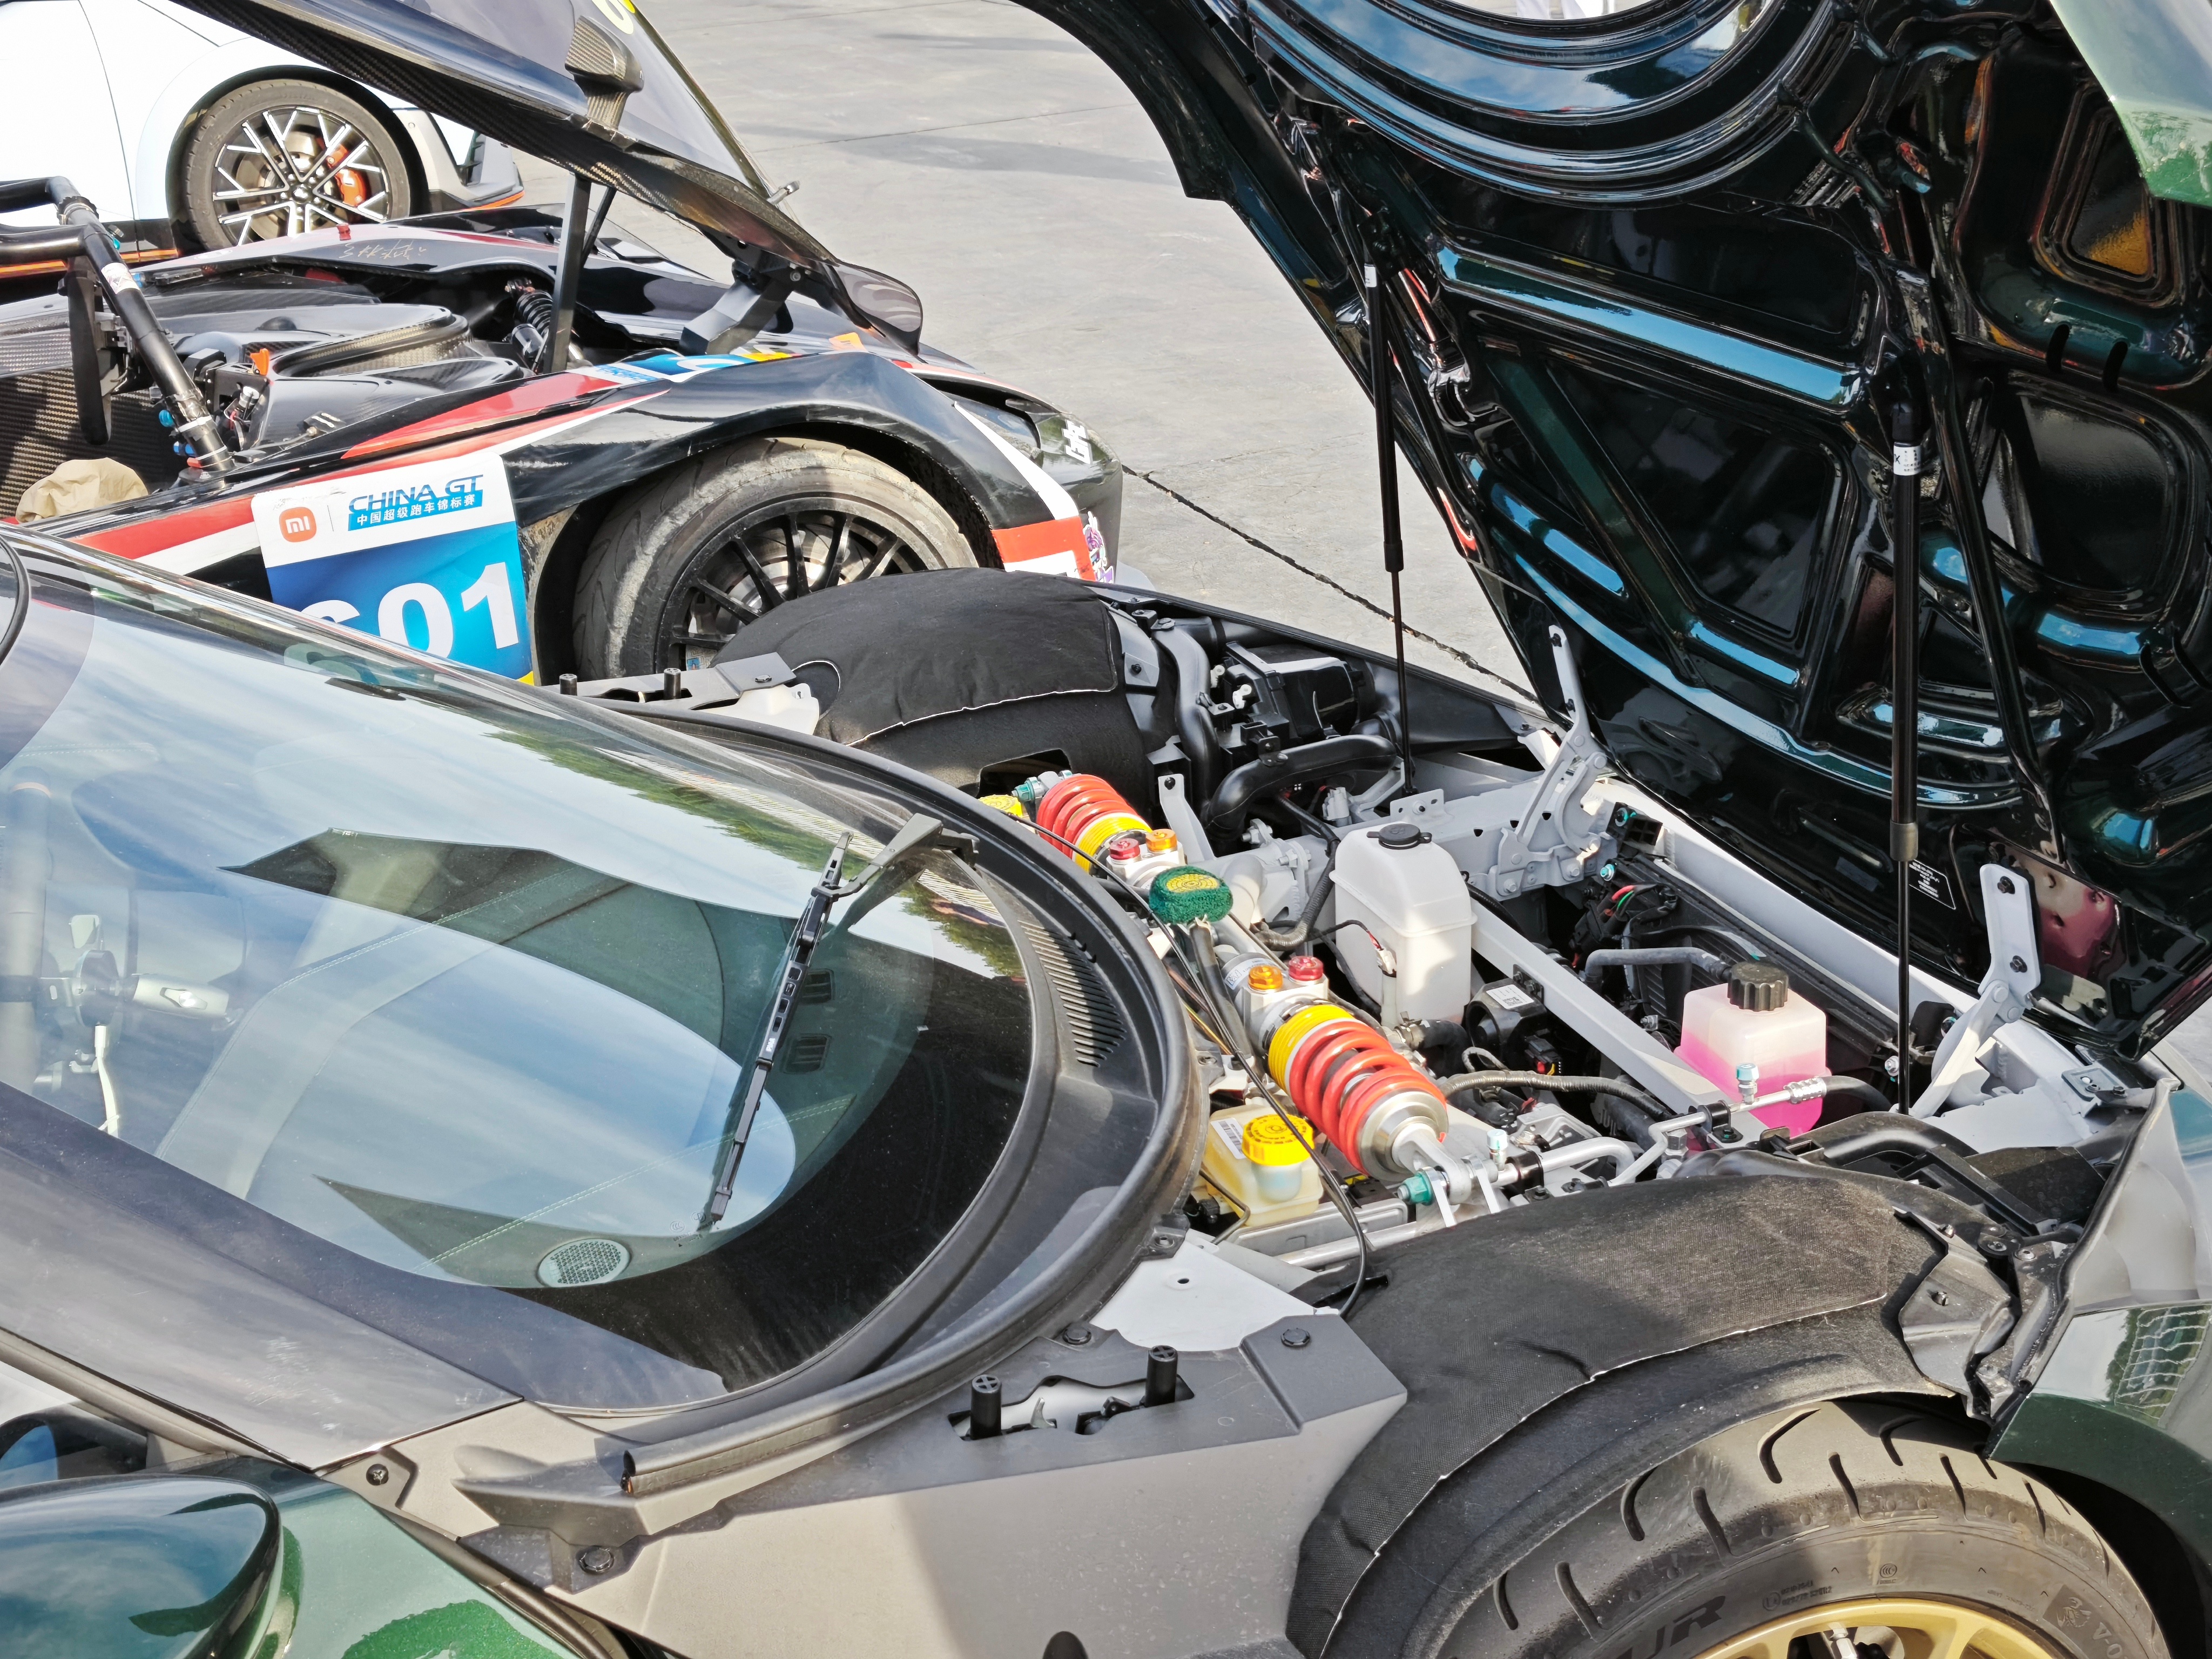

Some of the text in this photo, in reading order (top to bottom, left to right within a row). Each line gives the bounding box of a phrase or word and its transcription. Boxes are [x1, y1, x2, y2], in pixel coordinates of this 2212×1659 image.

[349, 474, 484, 513] CHINA GT
[356, 494, 476, 526] 中国超级跑车锦标赛
